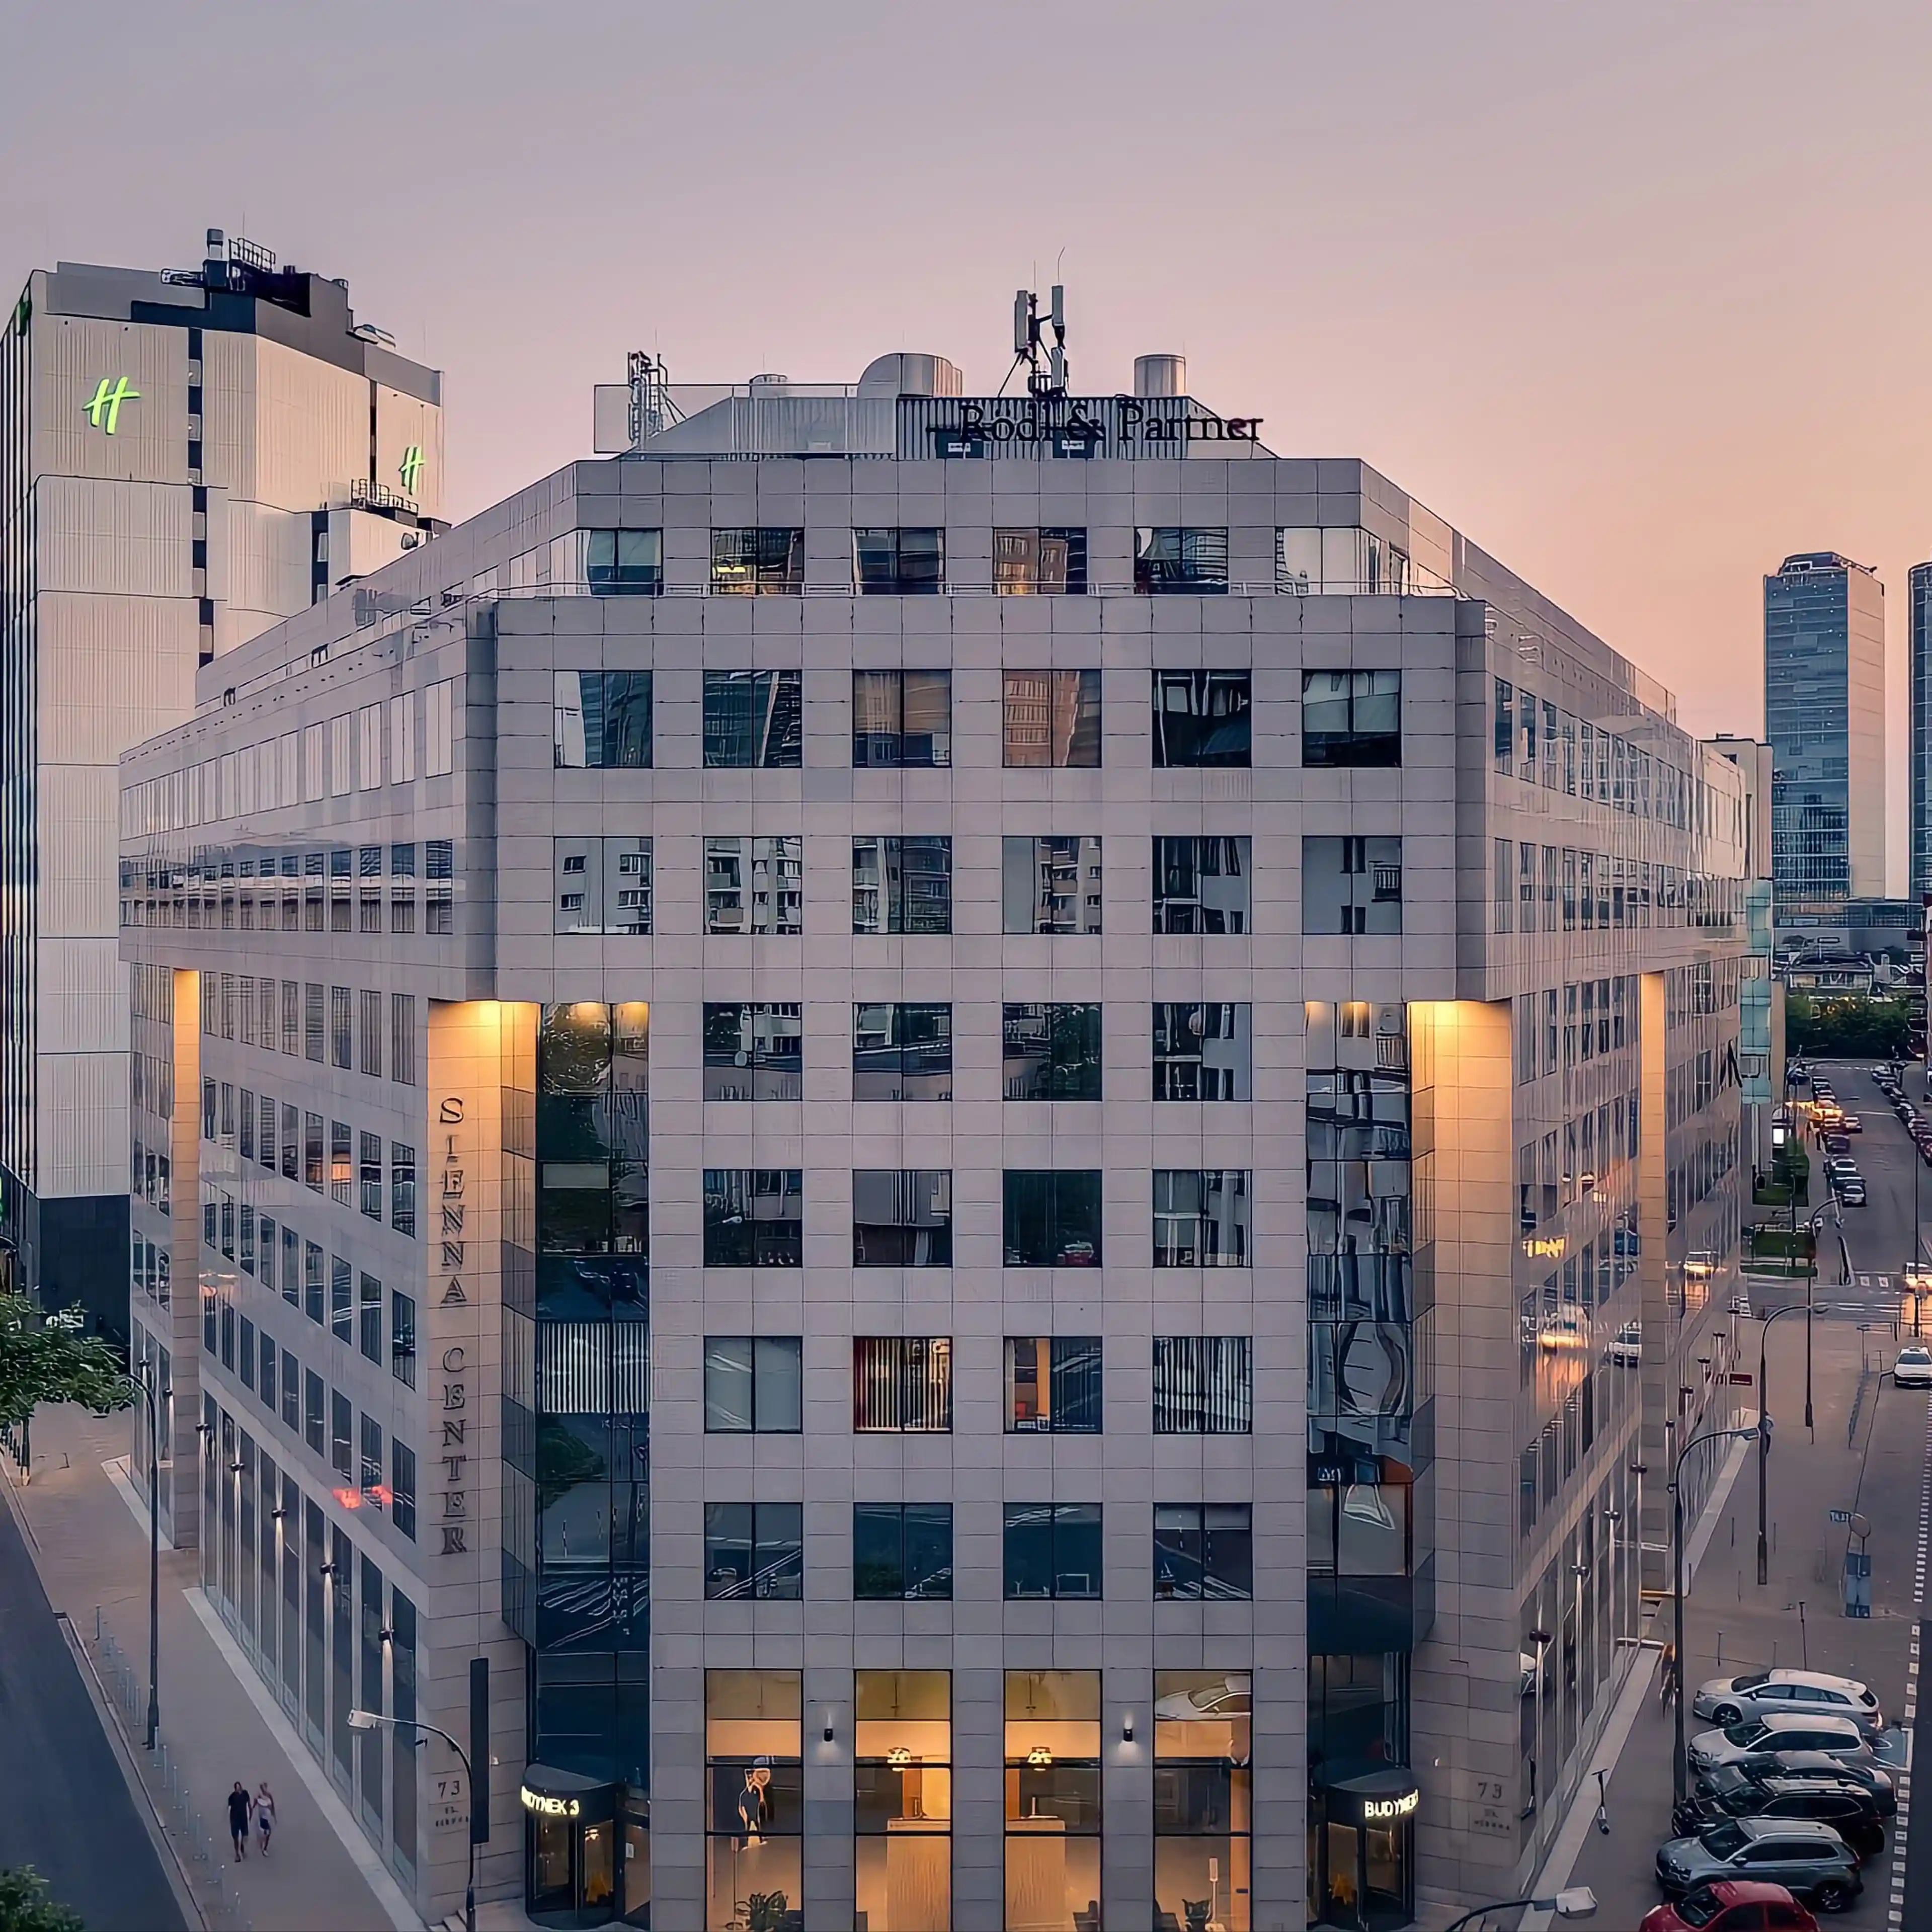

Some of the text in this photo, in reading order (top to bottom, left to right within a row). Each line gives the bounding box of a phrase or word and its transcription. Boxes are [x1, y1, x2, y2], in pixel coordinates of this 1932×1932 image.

[1117, 402, 1263, 441] Partner
[441, 1347, 467, 1556] CENTER
[437, 1780, 460, 1798] 73
[1478, 1782, 1502, 1799] 73
